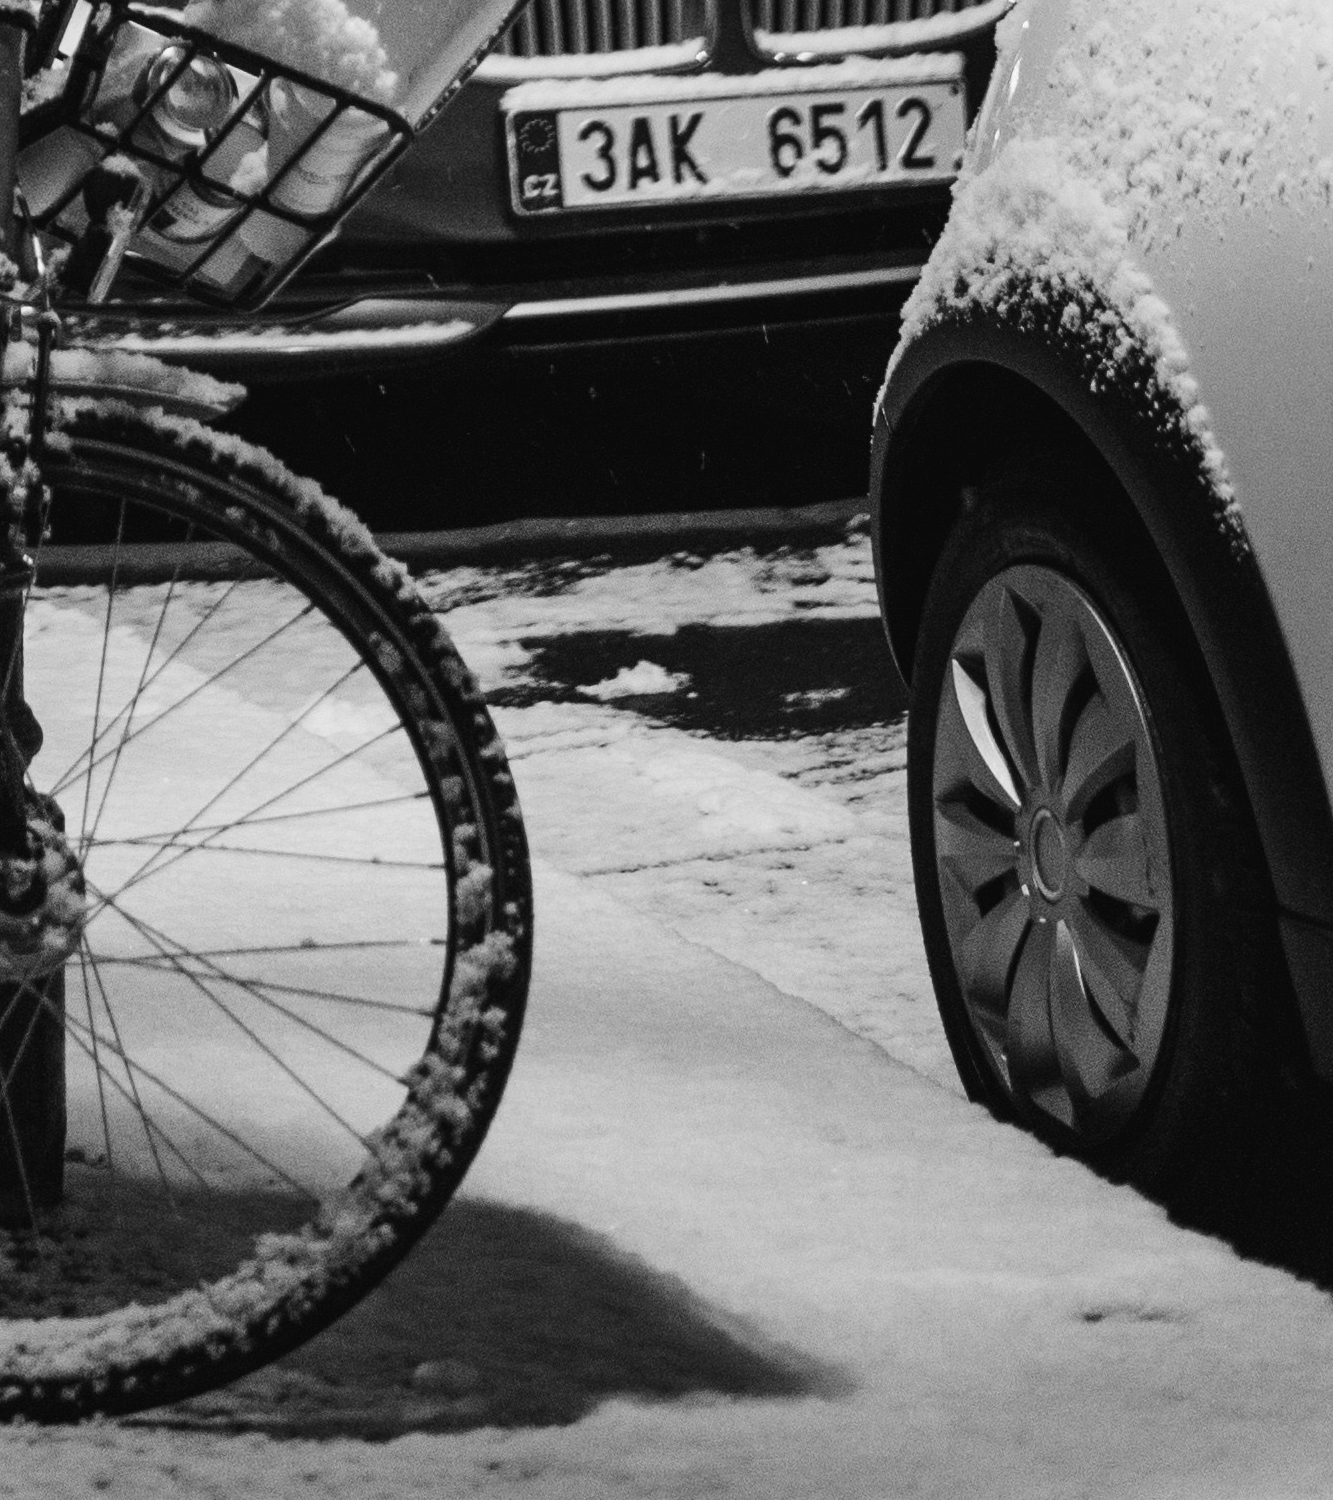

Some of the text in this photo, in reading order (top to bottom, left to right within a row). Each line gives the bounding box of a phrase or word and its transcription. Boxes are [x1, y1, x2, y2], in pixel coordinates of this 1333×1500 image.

[578, 97, 935, 192] 3AK 6512
[523, 172, 560, 199] CZ
